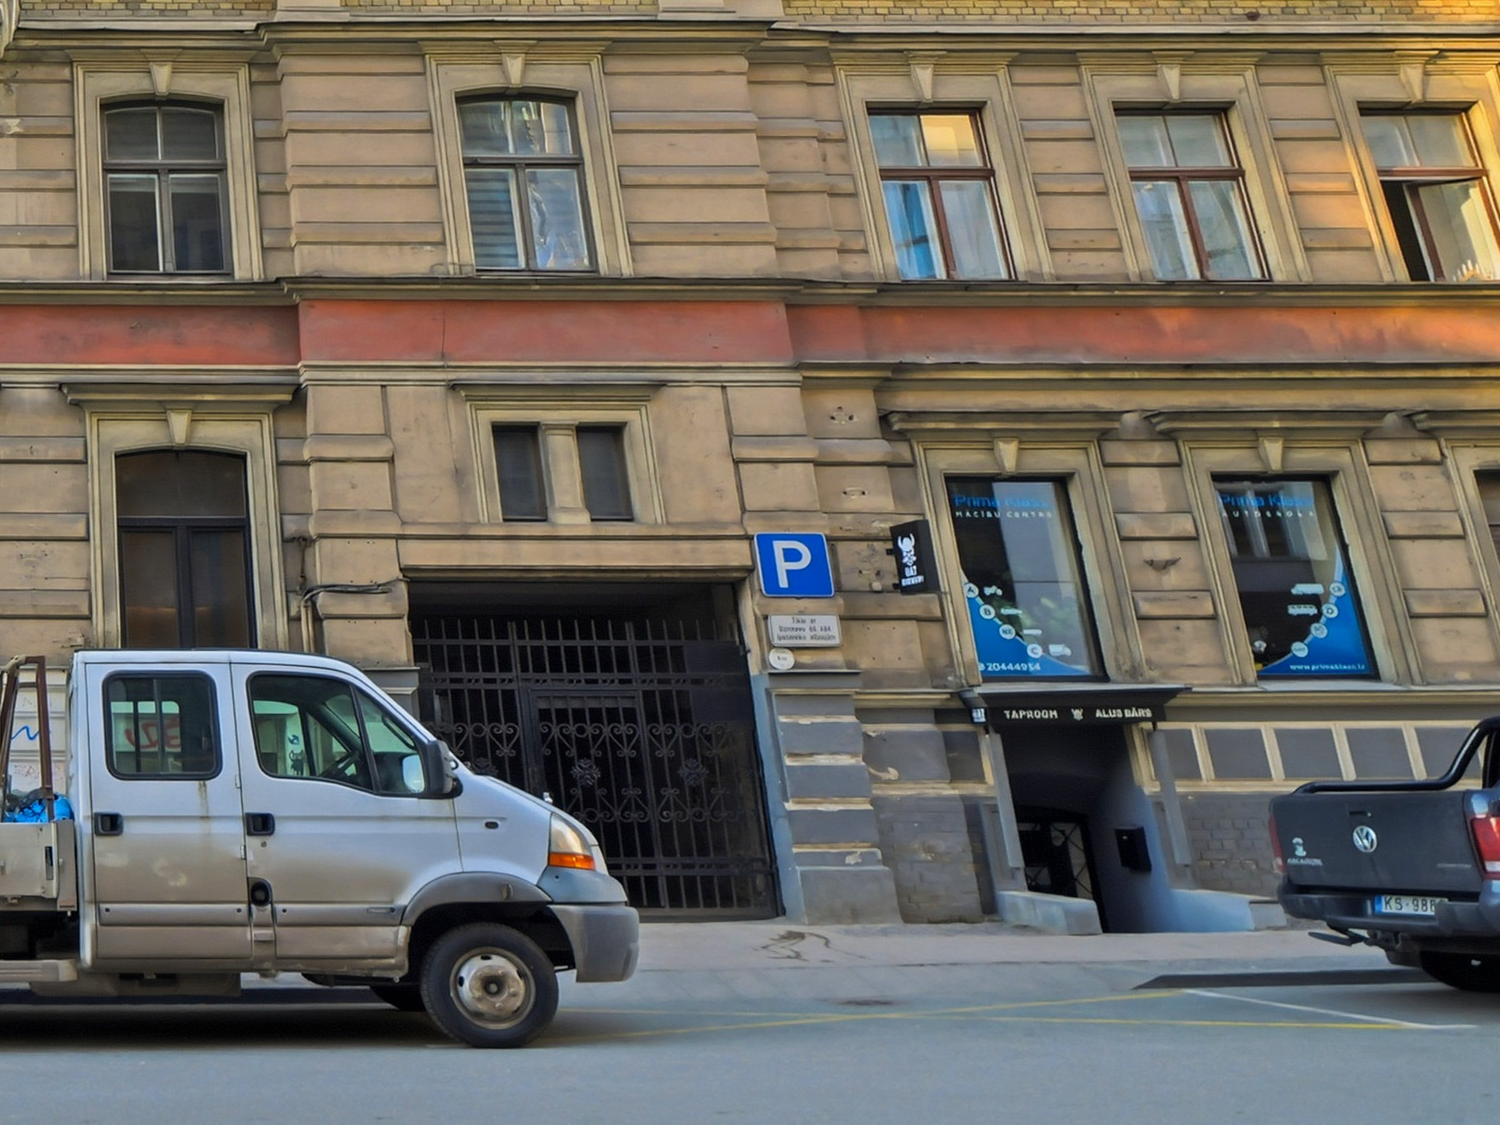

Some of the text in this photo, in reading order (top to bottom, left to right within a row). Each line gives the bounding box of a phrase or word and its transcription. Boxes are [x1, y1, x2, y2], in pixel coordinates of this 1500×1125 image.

[772, 540, 812, 589] P
[1003, 707, 1153, 720] TAPROOM ALUS BĀRS
